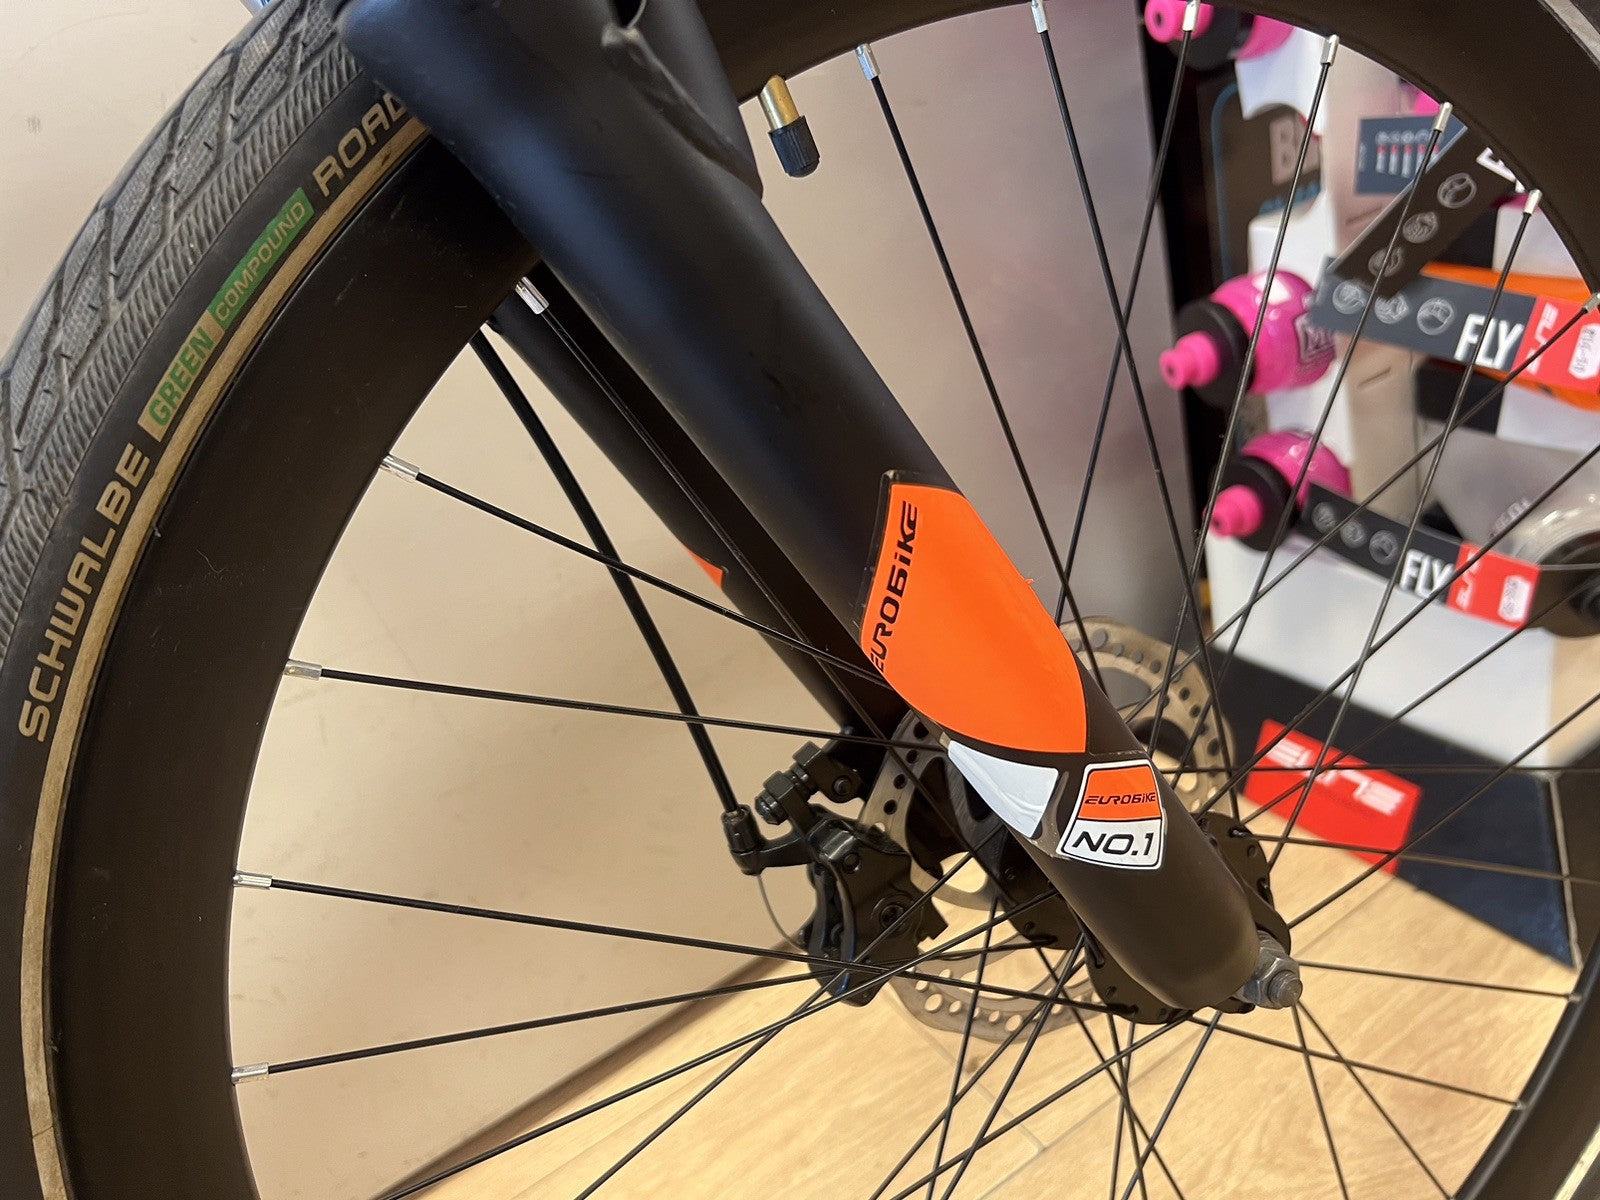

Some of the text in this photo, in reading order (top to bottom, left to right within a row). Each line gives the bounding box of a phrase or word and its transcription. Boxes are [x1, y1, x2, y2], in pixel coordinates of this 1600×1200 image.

[1454, 313, 1525, 370] FLY
[18, 442, 150, 743] SCHWALBE
[149, 325, 214, 427] GREEN
[215, 200, 306, 322] COMPOUND
[1400, 548, 1455, 600] FLY
